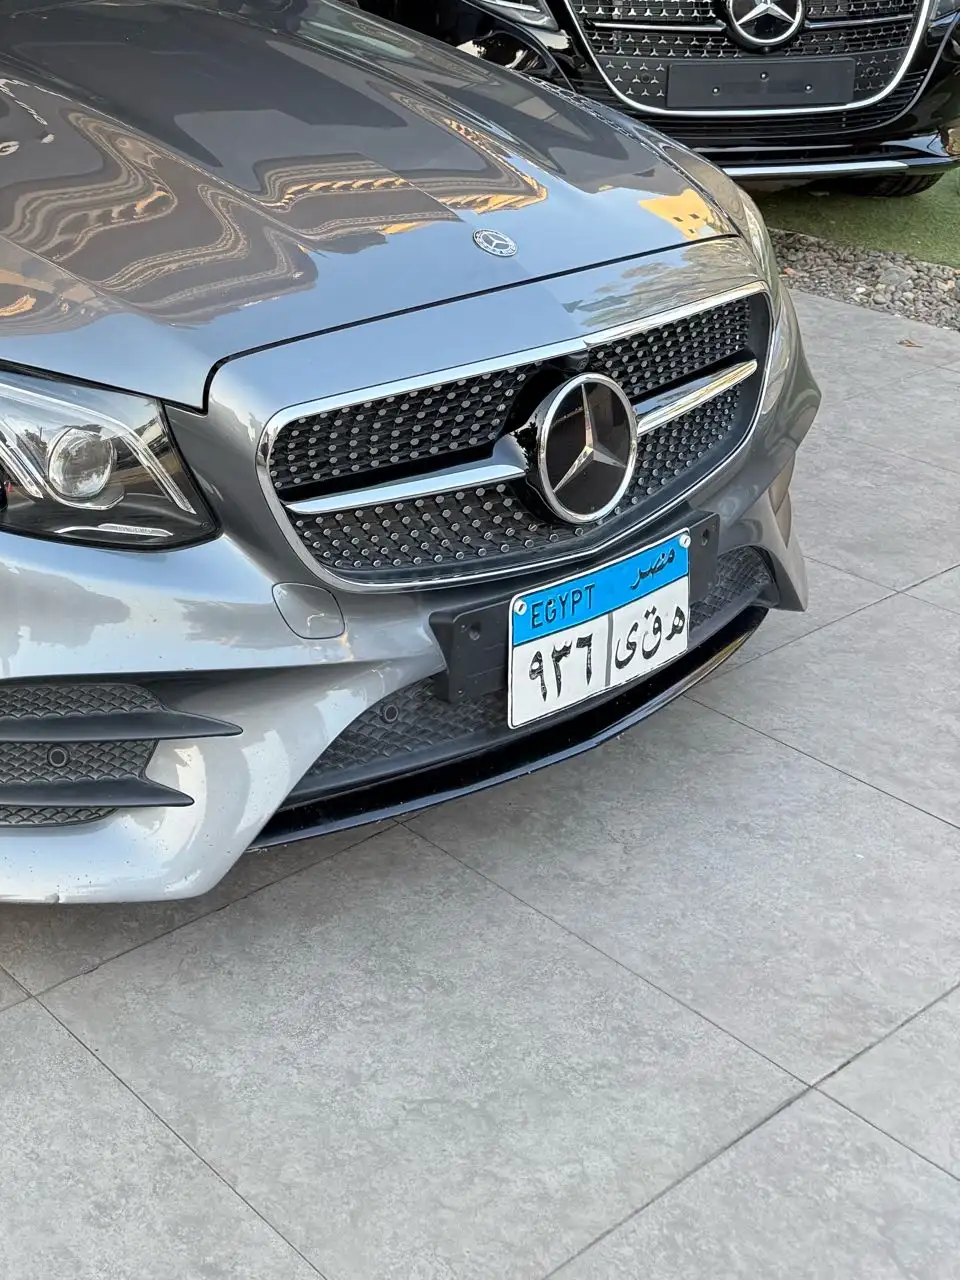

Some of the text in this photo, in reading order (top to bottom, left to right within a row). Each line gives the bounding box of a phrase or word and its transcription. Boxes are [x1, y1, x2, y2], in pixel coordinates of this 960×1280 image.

[629, 548, 676, 590] مصر
[531, 584, 596, 629] EGYPT
[528, 633, 593, 702] ٩٣٦
